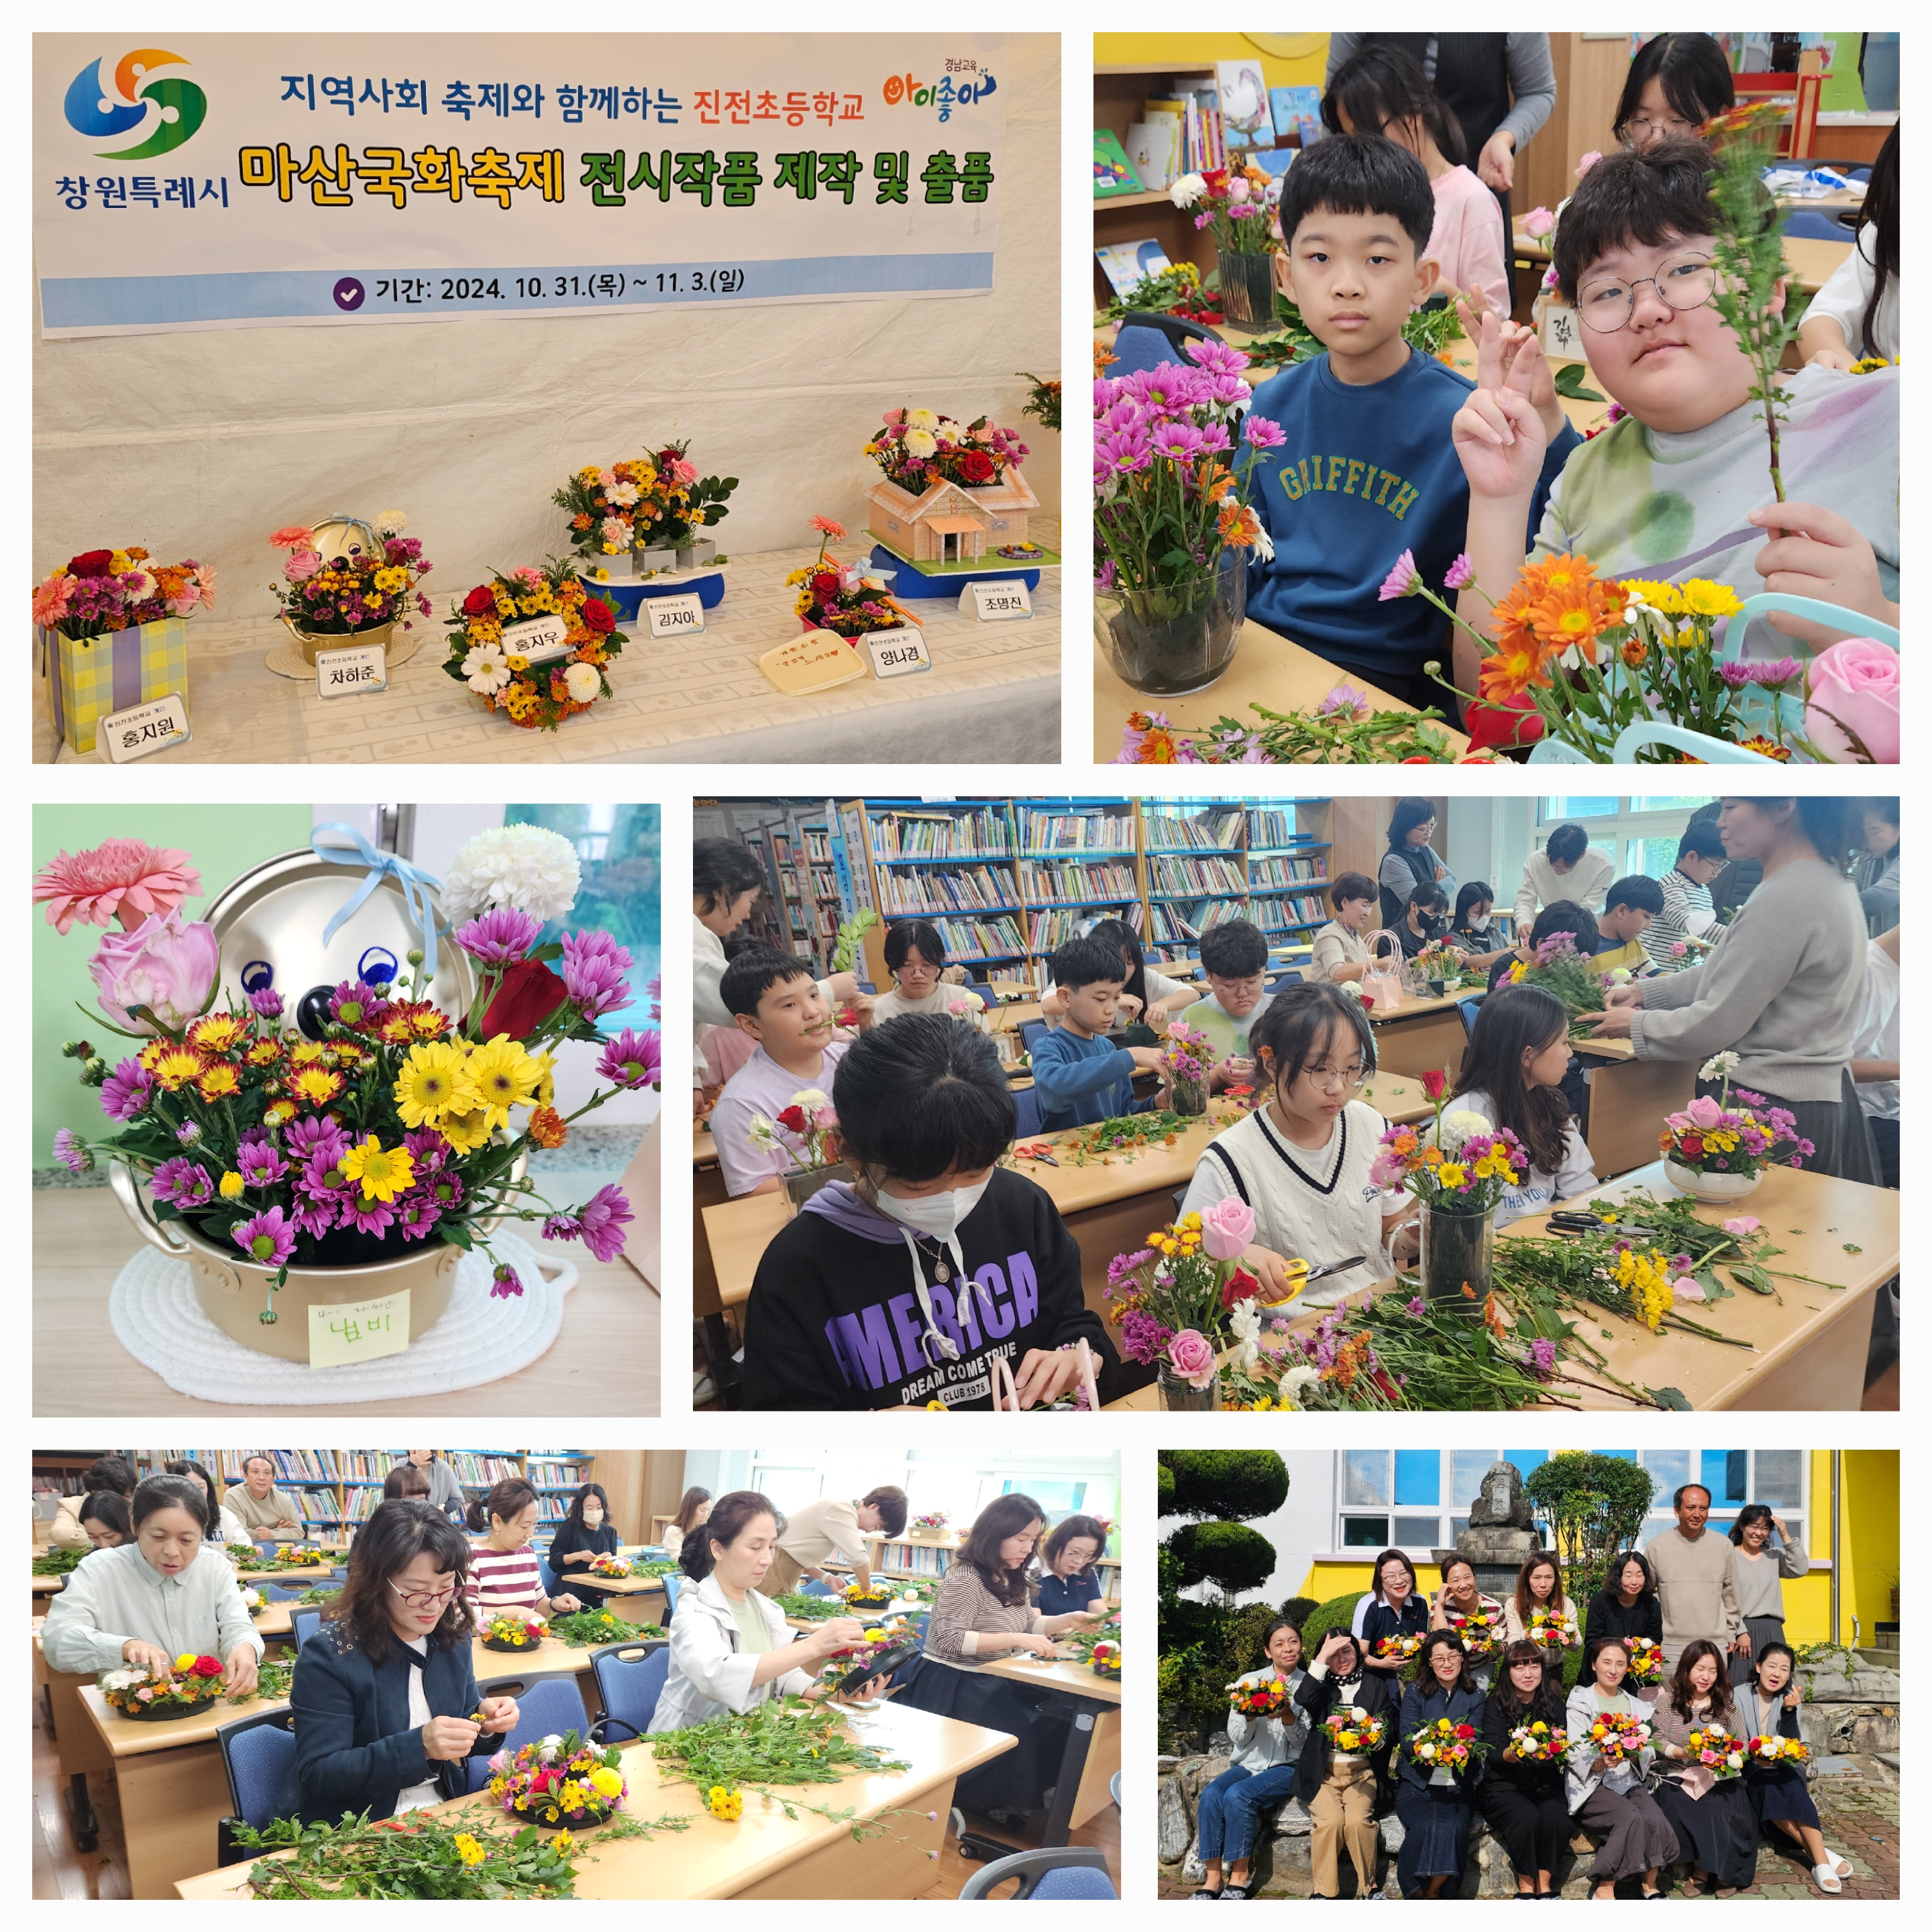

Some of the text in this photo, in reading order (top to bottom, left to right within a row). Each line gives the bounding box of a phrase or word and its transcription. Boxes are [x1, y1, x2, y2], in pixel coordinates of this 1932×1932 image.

[945, 58, 977, 74] 경남교육
[280, 74, 865, 127] 지역사회 축제와 함께하는 진전초등학교
[882, 72, 998, 123] 아이좋아
[238, 142, 994, 211] 마산국화축제 전시작품 제작 및 출품
[54, 175, 230, 211] 창원특례시
[376, 278, 433, 304] 기간:
[440, 276, 506, 301] 2024.
[515, 276, 547, 299] 10.
[553, 272, 626, 299] 31.(목)
[655, 272, 684, 294] 11.
[690, 268, 745, 295] 3.(일)
[1279, 454, 1420, 521] GRIFFITH
[984, 596, 1022, 610] 조명진
[658, 610, 695, 627] 김지아
[514, 631, 559, 652] 홍지우
[880, 645, 920, 666] 양나경
[329, 665, 376, 685] 차하준
[114, 710, 152, 728] 진전초등학교
[121, 716, 176, 749] 홍지원
[1502, 1195, 1526, 1210] THEN
[824, 1250, 1039, 1391] AMERICA
[901, 1342, 1017, 1405] DREAM COME TRUE
[943, 1382, 986, 1402] CLUB 1978
